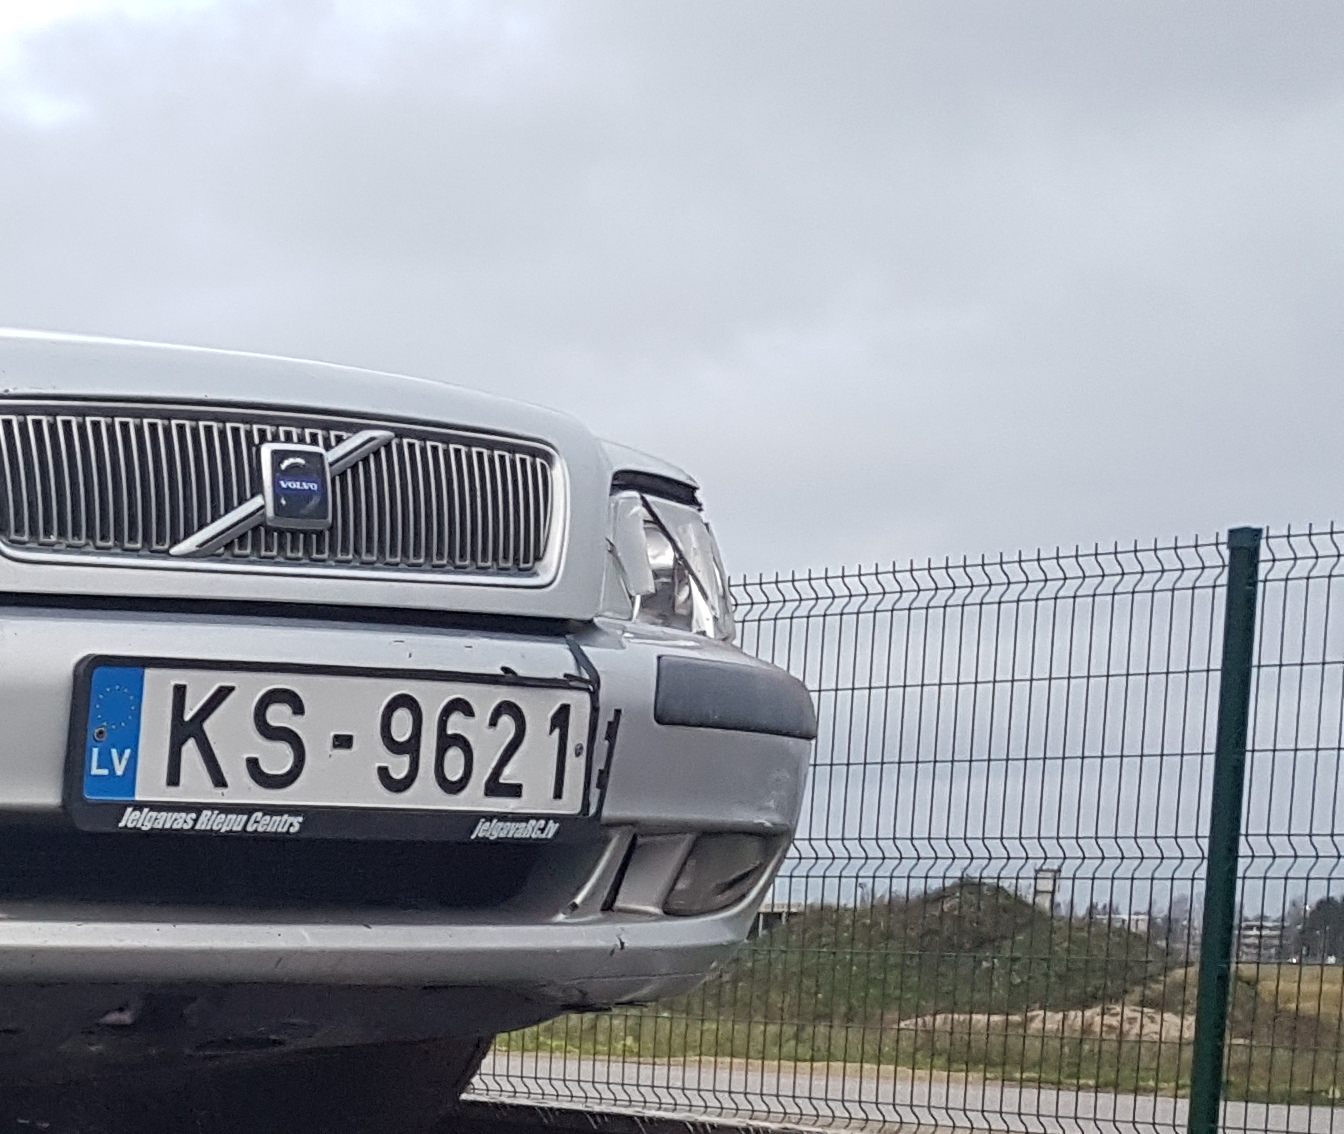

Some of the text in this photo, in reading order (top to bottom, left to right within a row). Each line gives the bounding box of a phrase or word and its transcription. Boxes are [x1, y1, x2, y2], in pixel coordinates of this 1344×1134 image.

[279, 480, 318, 491] VOLVO
[165, 683, 572, 801] KS-9621
[90, 748, 131, 777] LV
[118, 807, 303, 833] Jelgavas Riepu Centrs
